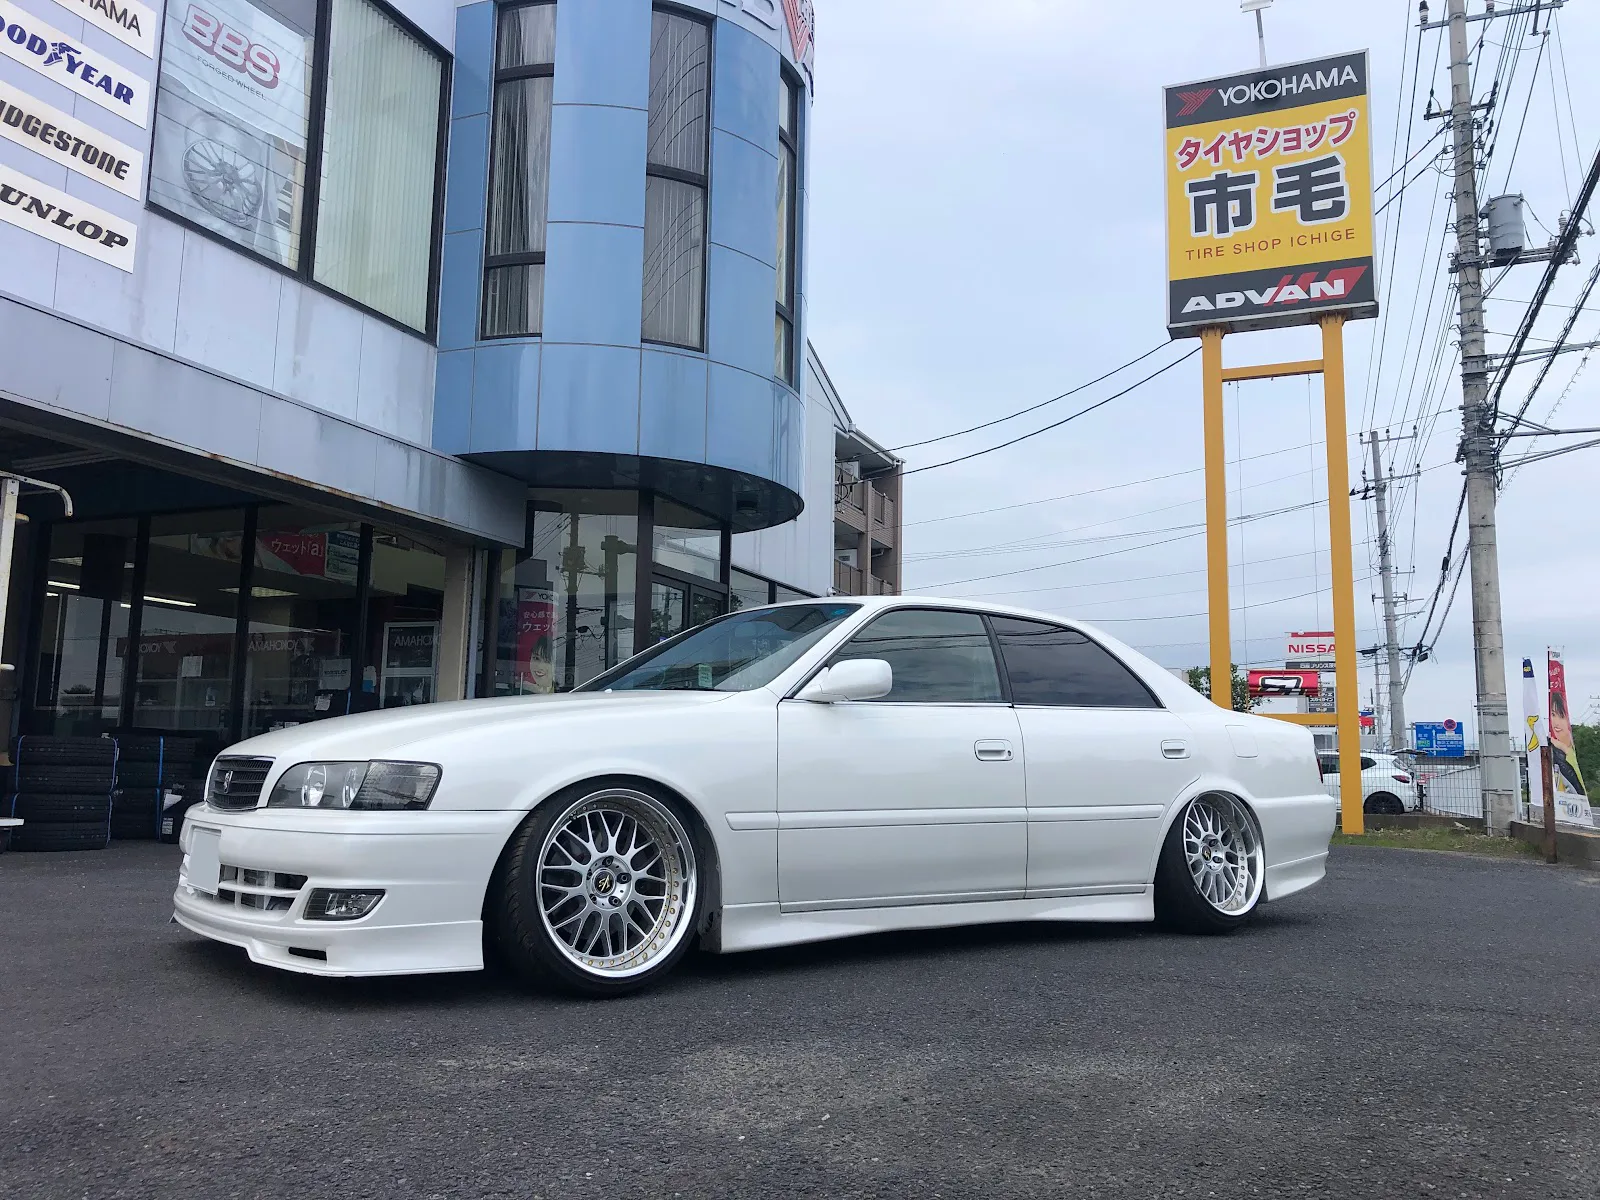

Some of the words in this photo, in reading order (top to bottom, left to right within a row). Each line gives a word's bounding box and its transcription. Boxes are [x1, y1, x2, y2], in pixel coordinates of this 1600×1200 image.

[81, 0, 142, 38] AMA
[0, 15, 135, 106] ODYEAR
[182, 4, 280, 89] BBS
[197, 56, 235, 83] FORGED
[236, 79, 267, 101] WHEEL
[1218, 65, 1359, 107] YOKOHAMA
[1177, 111, 1356, 169] タイヤショップ
[1188, 155, 1347, 235] 市毛
[1186, 246, 1225, 261] TIRE
[1233, 238, 1282, 255] SHOP
[1291, 228, 1356, 247] ICHIGE
[1181, 276, 1347, 313] ADVAN
